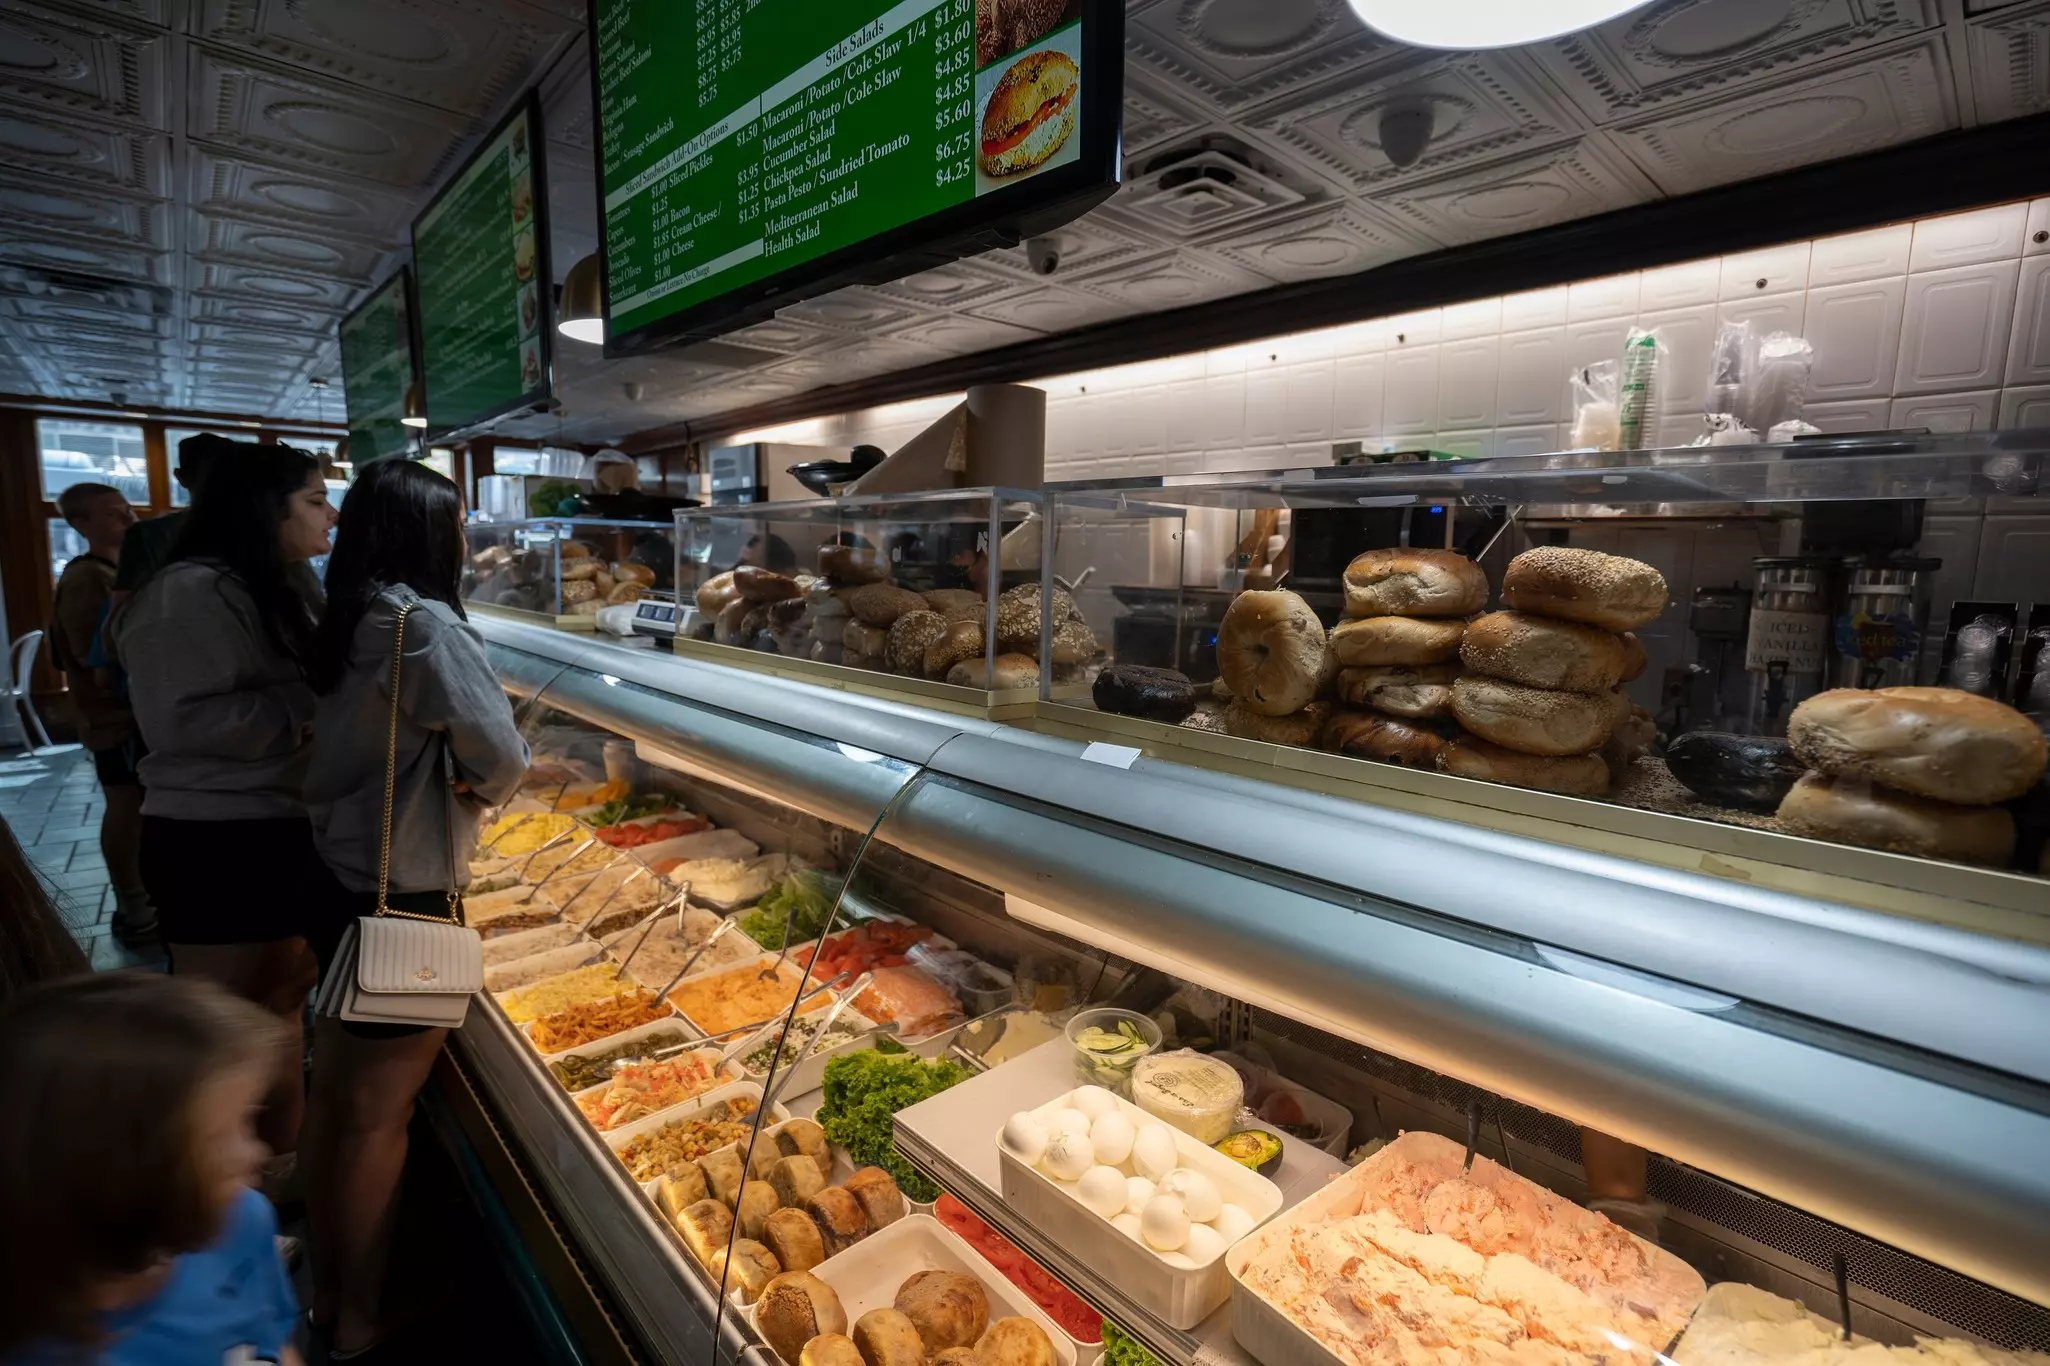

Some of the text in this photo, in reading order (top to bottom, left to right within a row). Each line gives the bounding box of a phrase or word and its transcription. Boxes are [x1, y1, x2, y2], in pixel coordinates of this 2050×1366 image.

[618, 6, 631, 31] Beef
[696, 6, 716, 33] $8.75
[720, 5, 741, 34] $5.85
[934, 0, 971, 30] $1.80
[697, 25, 716, 52] $8.95
[720, 24, 741, 53] $3.95
[825, 19, 884, 67] Side Salads
[935, 20, 971, 55] $3.60
[620, 60, 632, 81] Beef
[631, 43, 652, 71] Salami
[697, 45, 717, 71] $7.25
[721, 45, 742, 73] $5.75
[935, 45, 970, 80] $4.85
[697, 64, 717, 90] $8.75
[762, 95, 804, 132] Macaroni
[874, 39, 903, 65] Slaw
[907, 19, 927, 46] 1/4
[935, 71, 970, 105] $4.85
[623, 94, 637, 111] Ham
[698, 83, 718, 108] $5.75
[762, 118, 804, 155] Macaroni
[874, 66, 902, 91] Slaw
[935, 99, 971, 131] $5.60
[623, 141, 645, 162] Sausage
[645, 116, 674, 147] Sandwich
[736, 122, 759, 147] $1.50
[763, 118, 836, 170] Cucumber Salad
[935, 130, 971, 162] $6.75
[642, 160, 671, 186] Sandwich
[671, 141, 699, 166] Add-On
[699, 123, 729, 147] Options
[763, 143, 832, 192] Chickpea Salad
[651, 153, 713, 199] $1.00 Sliced Pickles
[737, 162, 759, 186] $3.95
[764, 193, 786, 213] Pasta
[788, 181, 812, 202] Pesto
[819, 148, 865, 186] Sundried
[866, 134, 910, 164] Tomato
[936, 156, 971, 188] $4.25
[738, 182, 760, 206] $1.25
[652, 204, 691, 233] $1.00 Bacon
[738, 202, 760, 225] $1.35
[764, 180, 859, 238] Mediterranean Salad
[653, 230, 670, 249] $1.85
[671, 222, 693, 240] Cream
[692, 207, 718, 228] Cheese
[764, 219, 820, 258] Health Salad
[654, 239, 695, 266] $1.00 Cheese
[624, 265, 642, 280] Olives
[654, 264, 671, 282] $1.00
[683, 272, 692, 284] No
[691, 265, 711, 280] Charge
[1755, 639, 1820, 651] VANILLA
